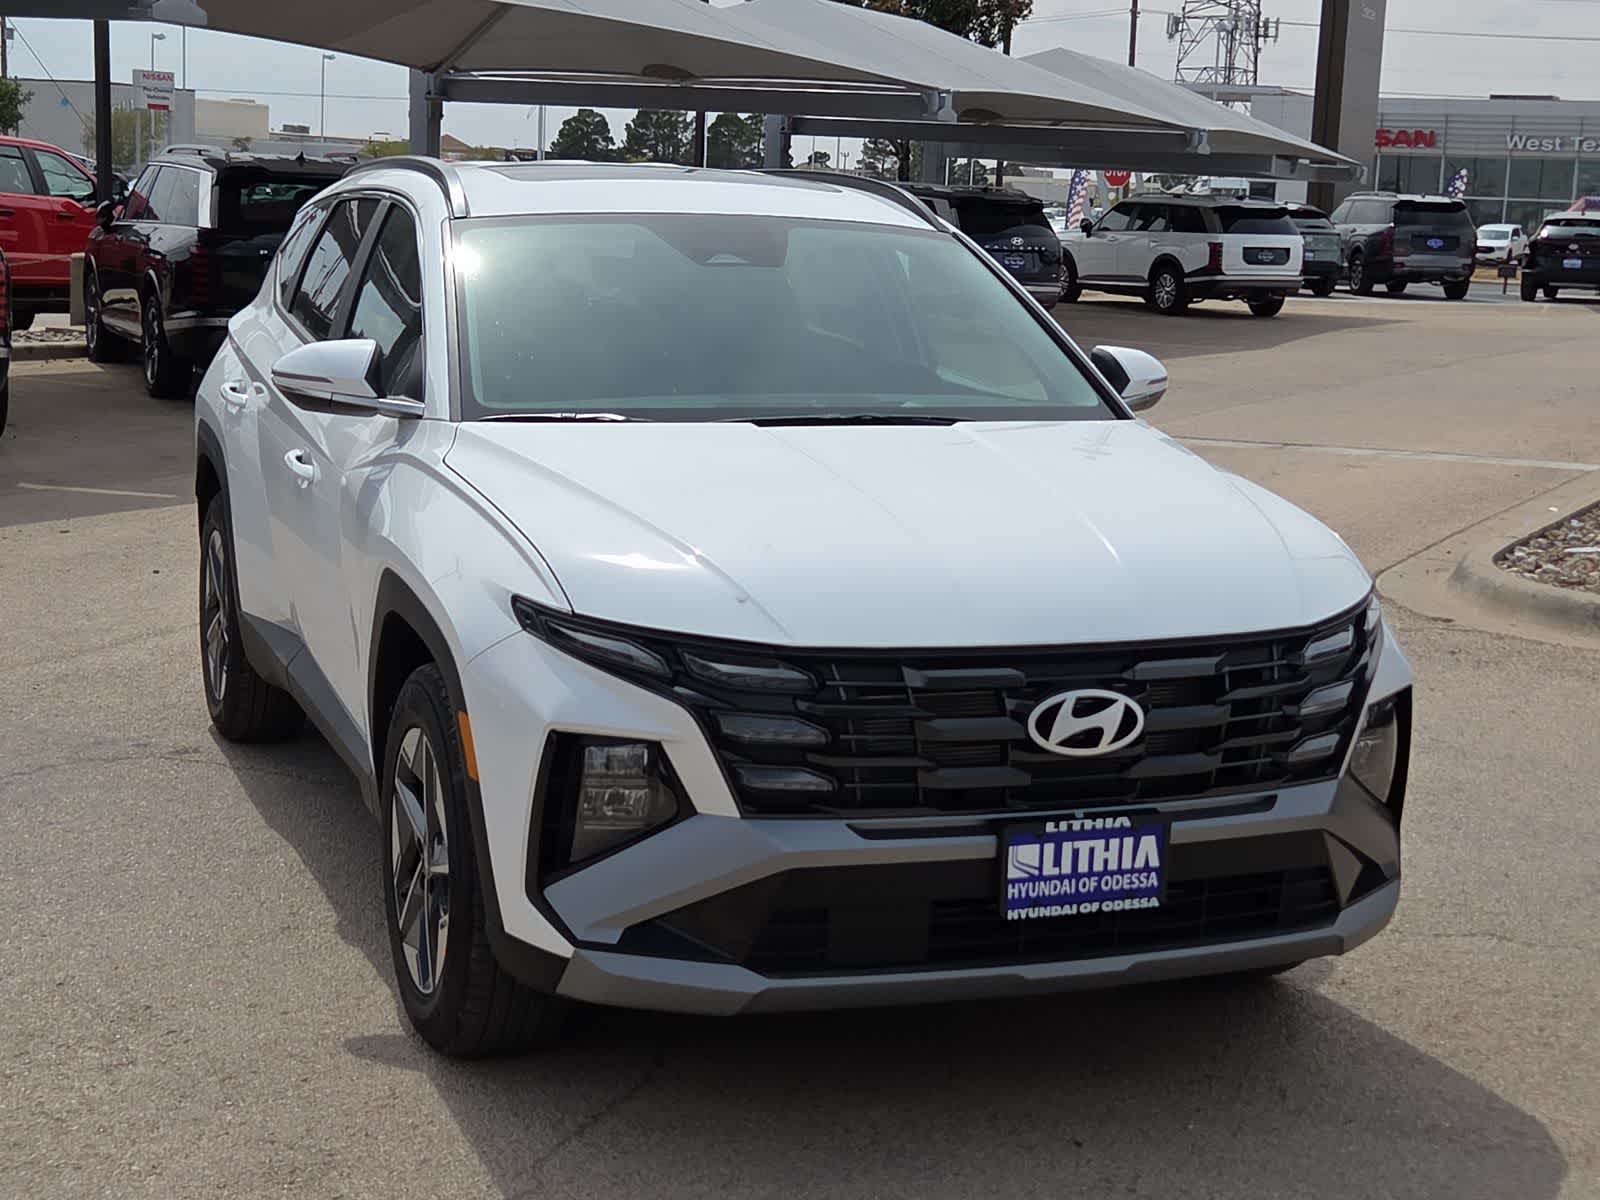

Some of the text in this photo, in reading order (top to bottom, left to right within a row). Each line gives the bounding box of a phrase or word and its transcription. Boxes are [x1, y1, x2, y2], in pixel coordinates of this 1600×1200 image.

[143, 72, 173, 81] NISSAN
[1506, 135, 1562, 151] West
[1045, 816, 1132, 832] LITHIA
[1042, 835, 1160, 876] LITHIA
[1007, 871, 1159, 900] HYUNDAI OF ODESSA
[1007, 897, 1160, 920] HYUNDAI OF ODESSA
